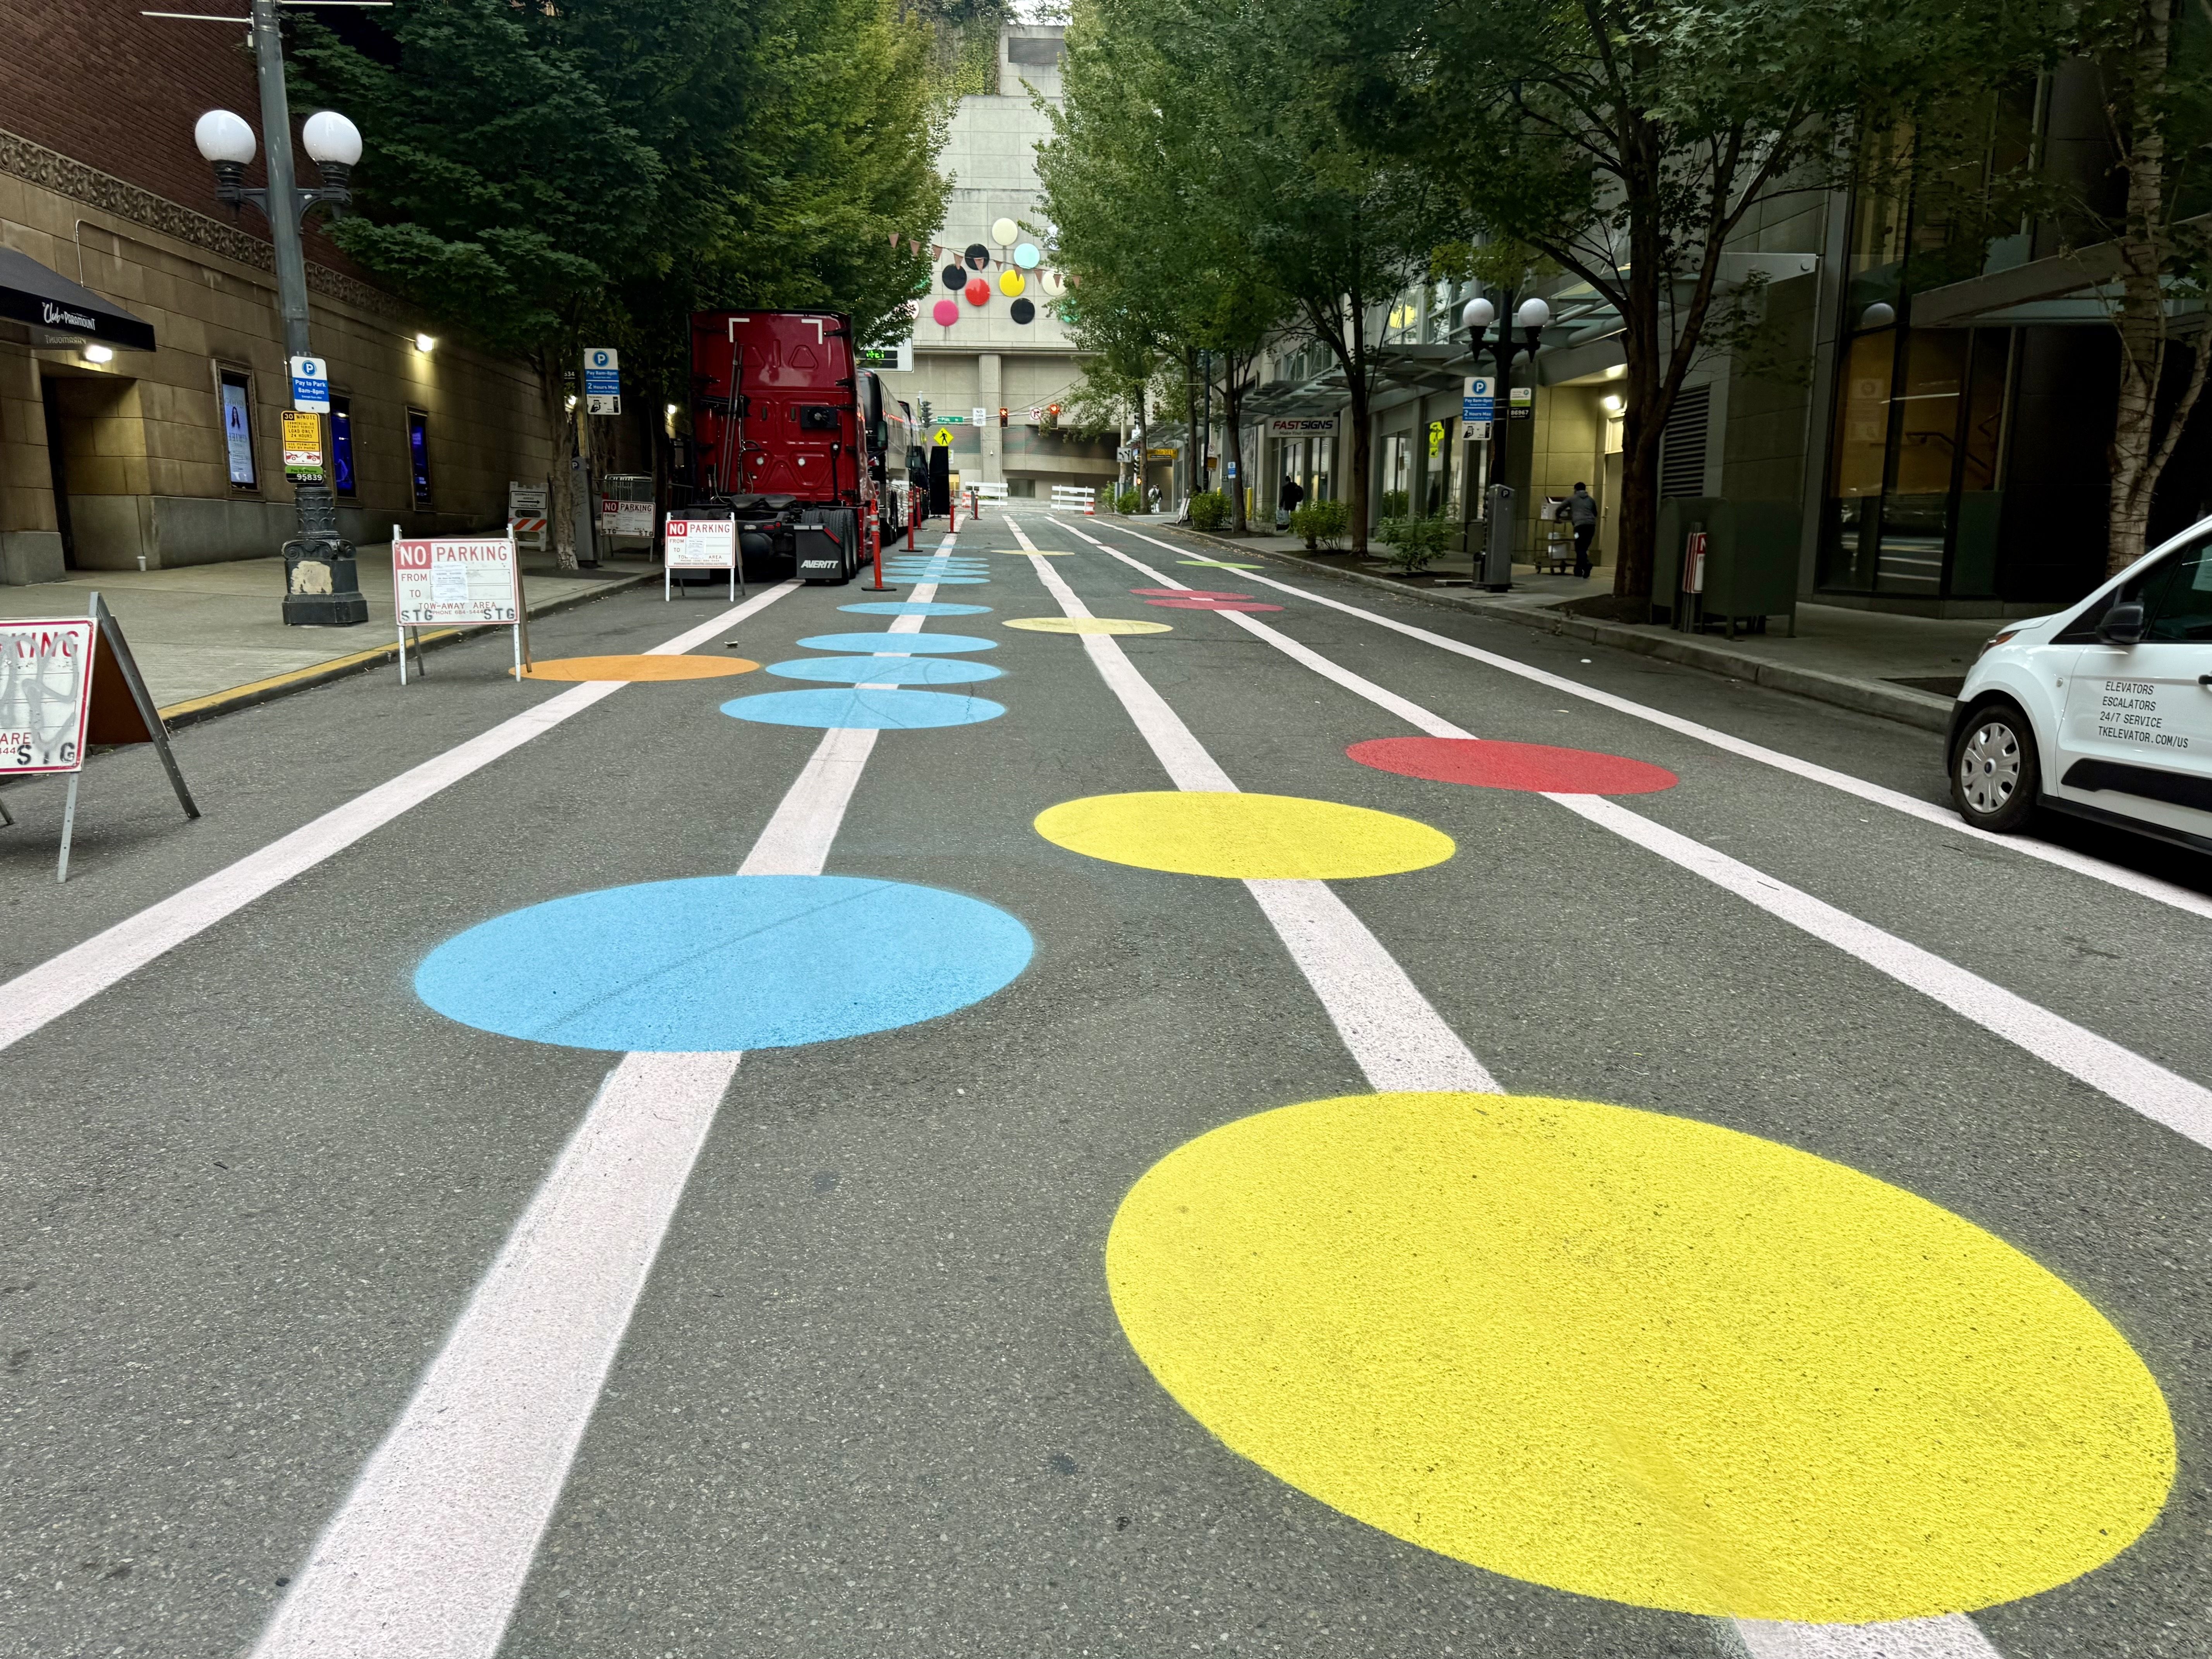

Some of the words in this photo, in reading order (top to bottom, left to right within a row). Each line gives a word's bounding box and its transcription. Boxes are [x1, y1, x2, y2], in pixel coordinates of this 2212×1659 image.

[44, 302, 61, 323] Club
[64, 311, 95, 330] PARAMOUNT
[306, 363, 314, 373] P
[298, 387, 325, 395] 8am-8pm
[1273, 420, 1333, 430] FASTSIGNS
[605, 502, 617, 511] NO
[621, 503, 651, 512] PARKING
[669, 523, 685, 535] NO
[690, 524, 730, 533] PARKING
[1700, 538, 1706, 551] N
[400, 546, 426, 567] NO
[436, 546, 507, 562] PARKING
[800, 560, 838, 568] AVERITT
[401, 574, 427, 582] FROM
[410, 590, 421, 598] TO
[0, 630, 79, 658] KING
[2106, 681, 2154, 695] ELEVATORS
[2102, 696, 2156, 711] ESCALATORS
[2100, 711, 2121, 722] 24/7
[2123, 714, 2162, 728] SERVICE
[0, 732, 35, 745] ARE
[2098, 726, 2188, 748] TKELEVATOR.COM/US
